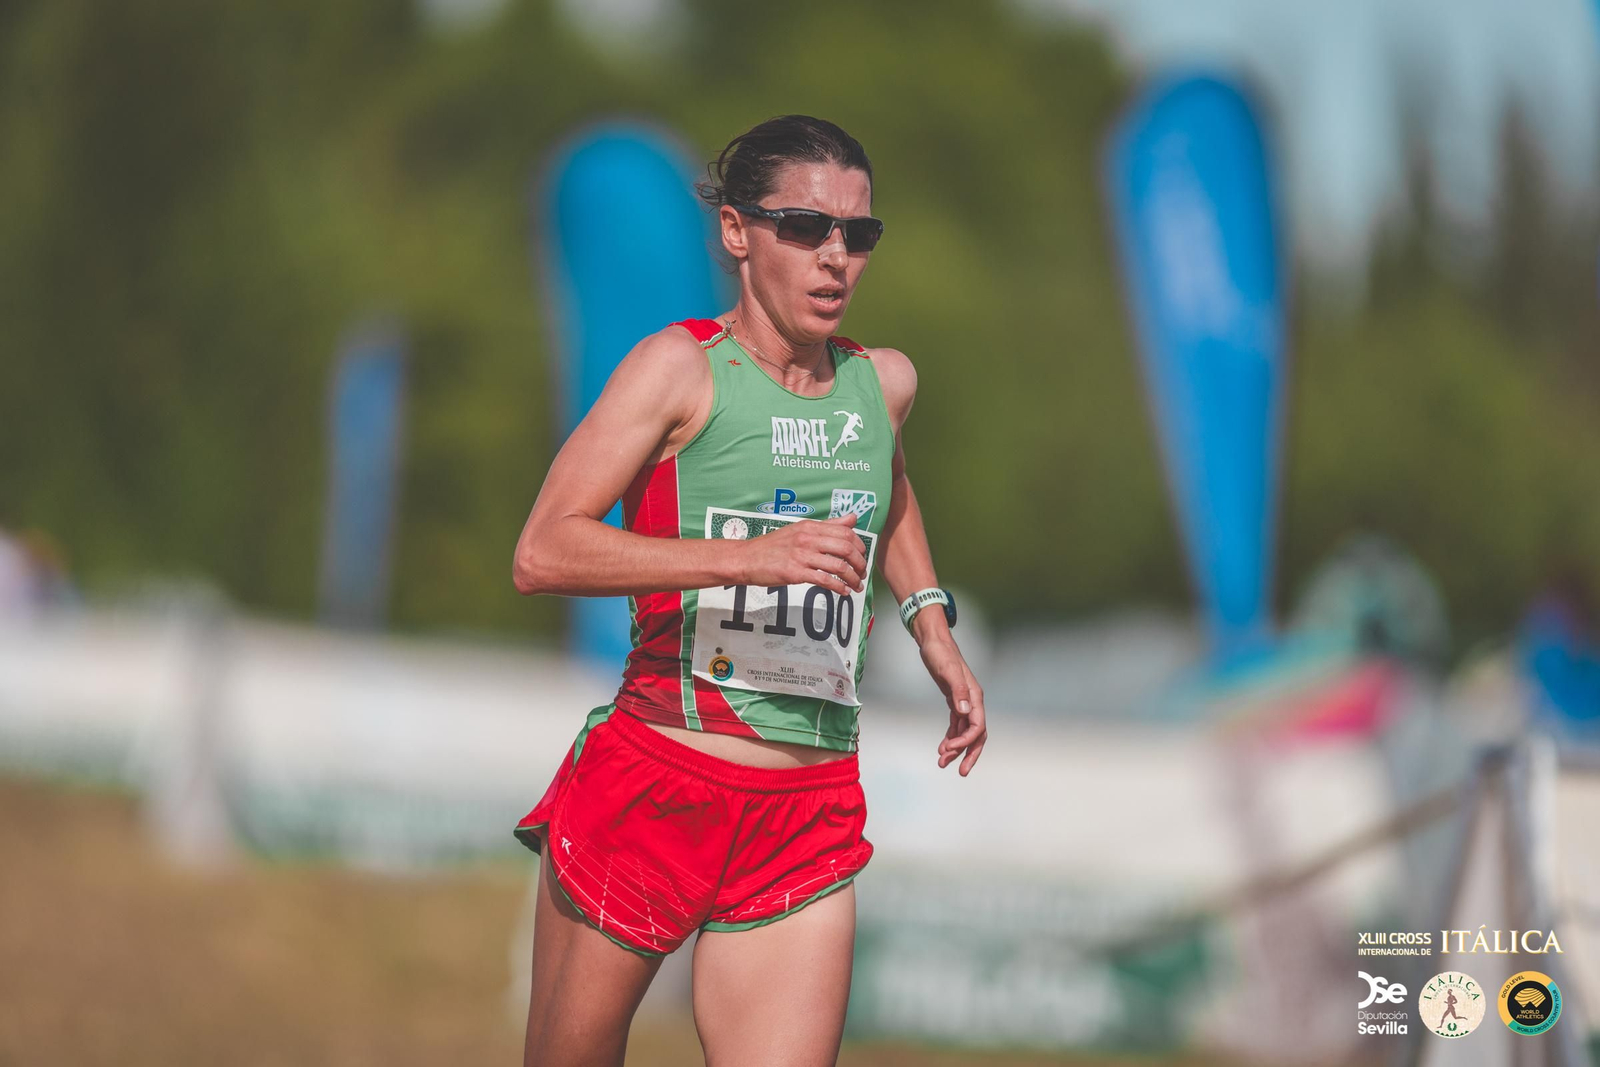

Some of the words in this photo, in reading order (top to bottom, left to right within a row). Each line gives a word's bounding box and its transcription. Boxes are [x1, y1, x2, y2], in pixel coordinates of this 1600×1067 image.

[771, 416, 831, 457] ATARFE
[772, 455, 831, 470] Atletismo
[834, 459, 871, 472] Atarfe
[773, 488, 808, 514] Poncho
[720, 584, 855, 648] 1100
[762, 671, 800, 680] INTERNACIONAL
[772, 677, 800, 685] NOVIEMBRE
